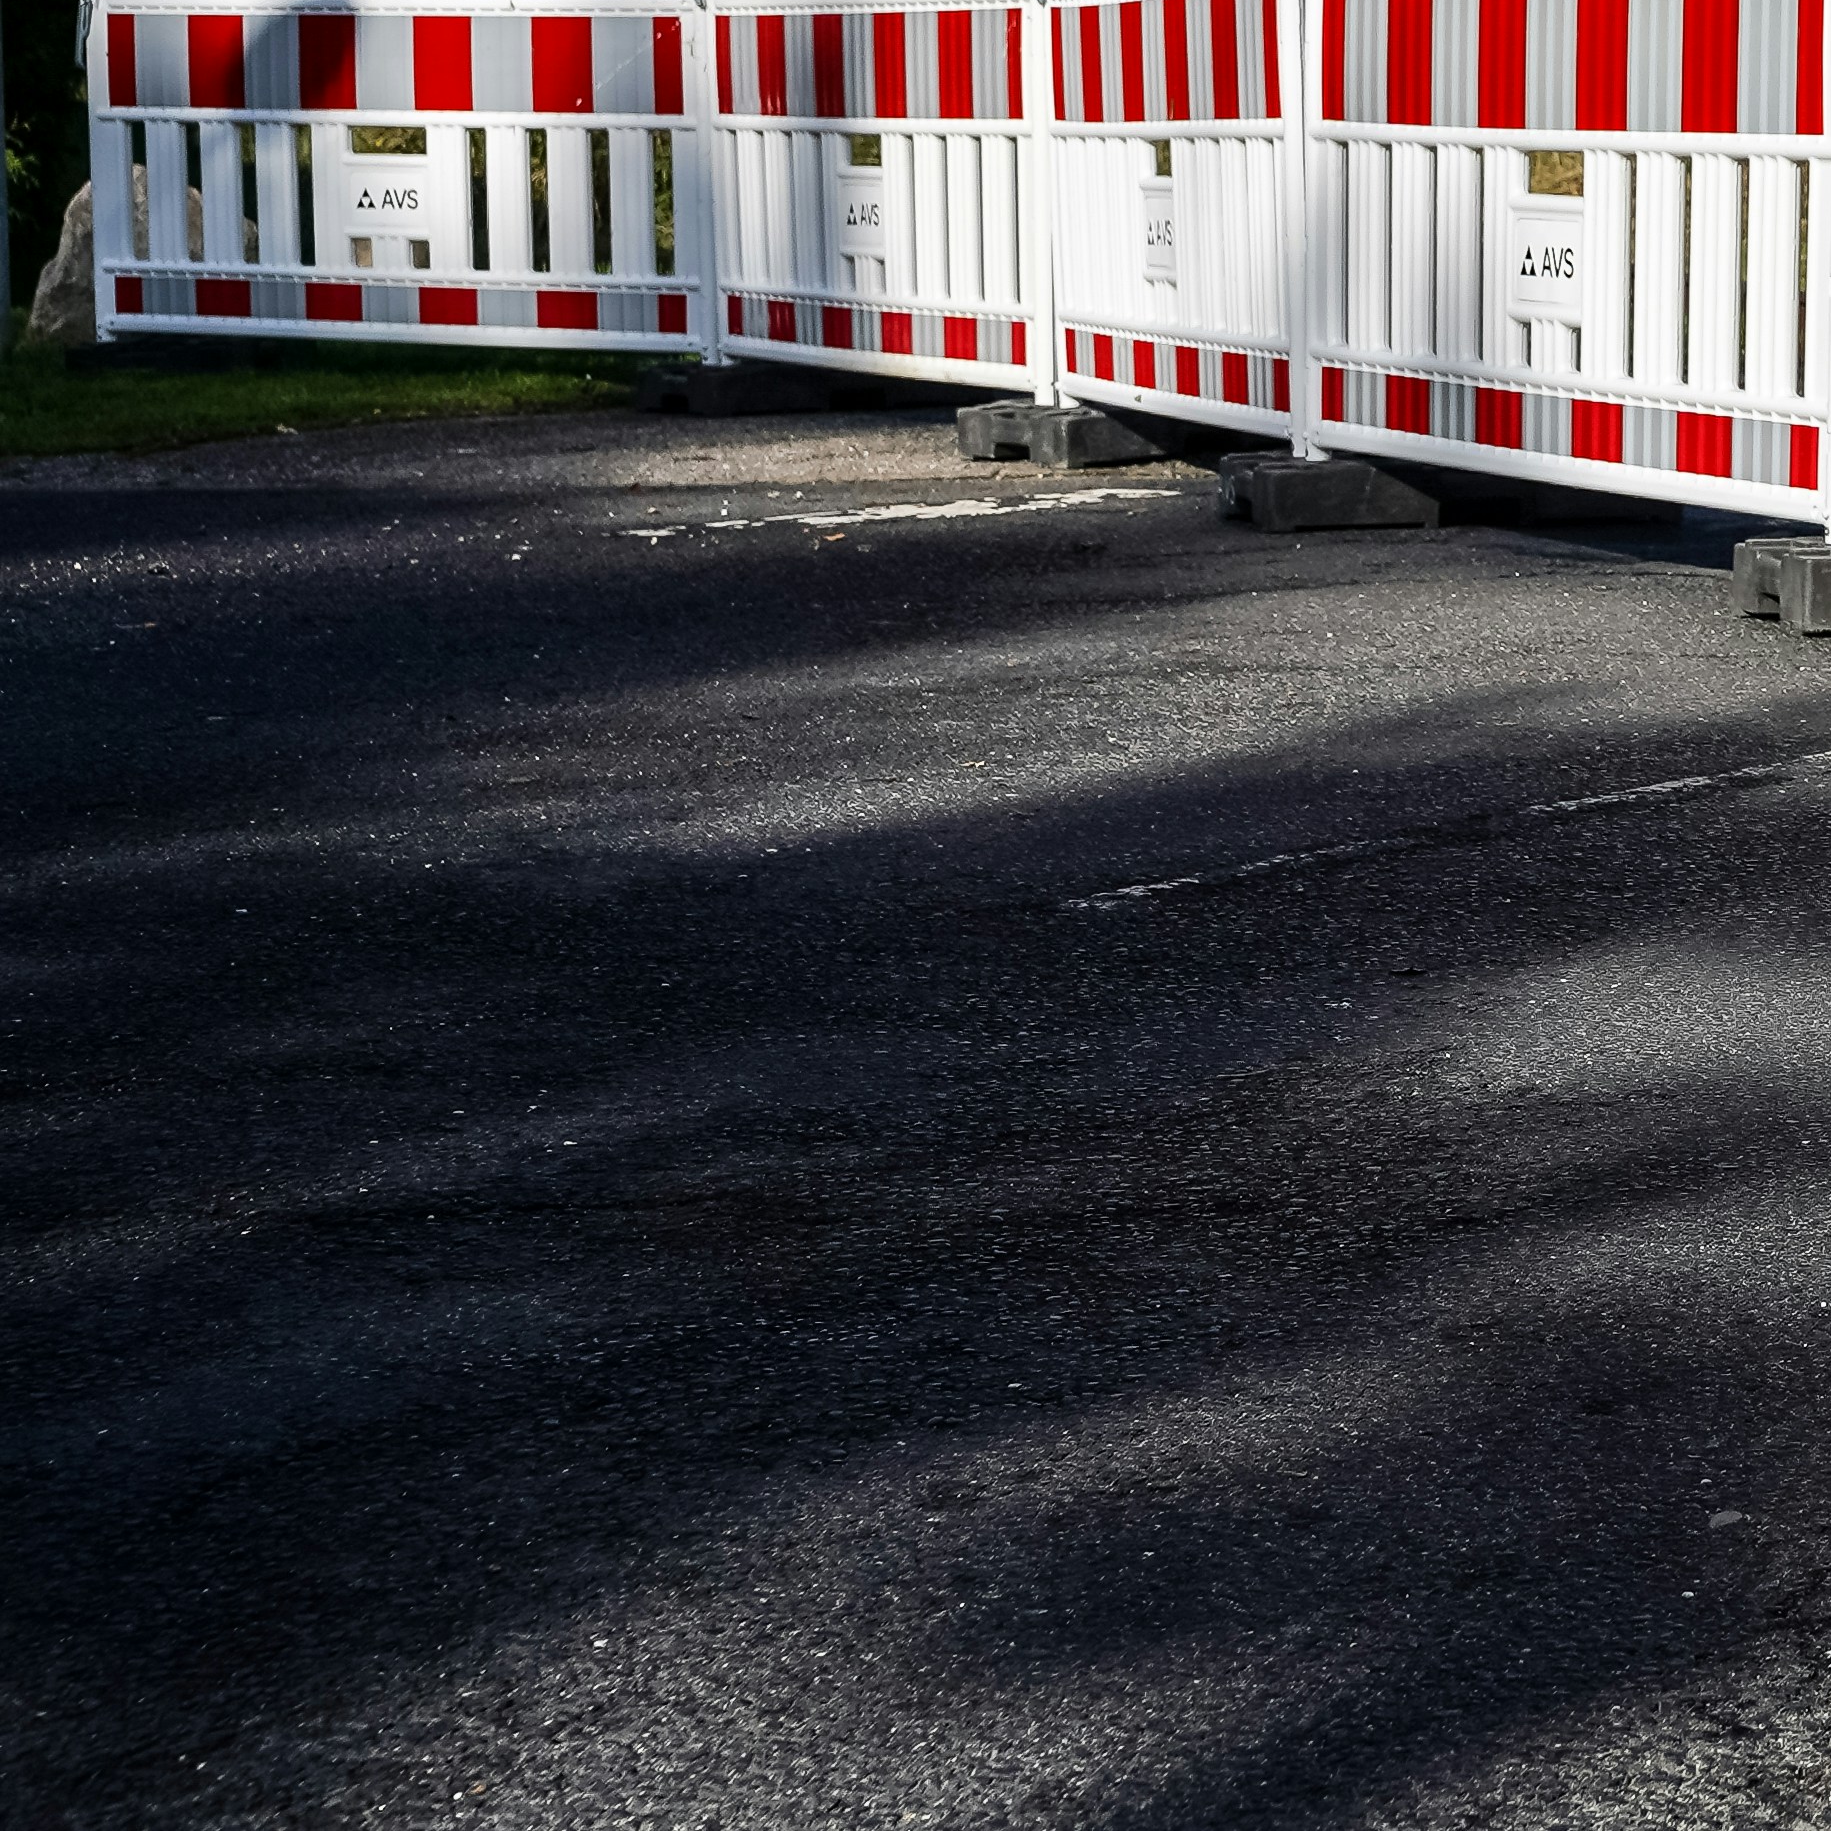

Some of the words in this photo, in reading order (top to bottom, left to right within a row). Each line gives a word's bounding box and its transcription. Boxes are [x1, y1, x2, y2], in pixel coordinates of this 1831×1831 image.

[382, 188, 418, 210] AVS
[861, 202, 880, 226] AVS
[1541, 246, 1574, 279] AVS
